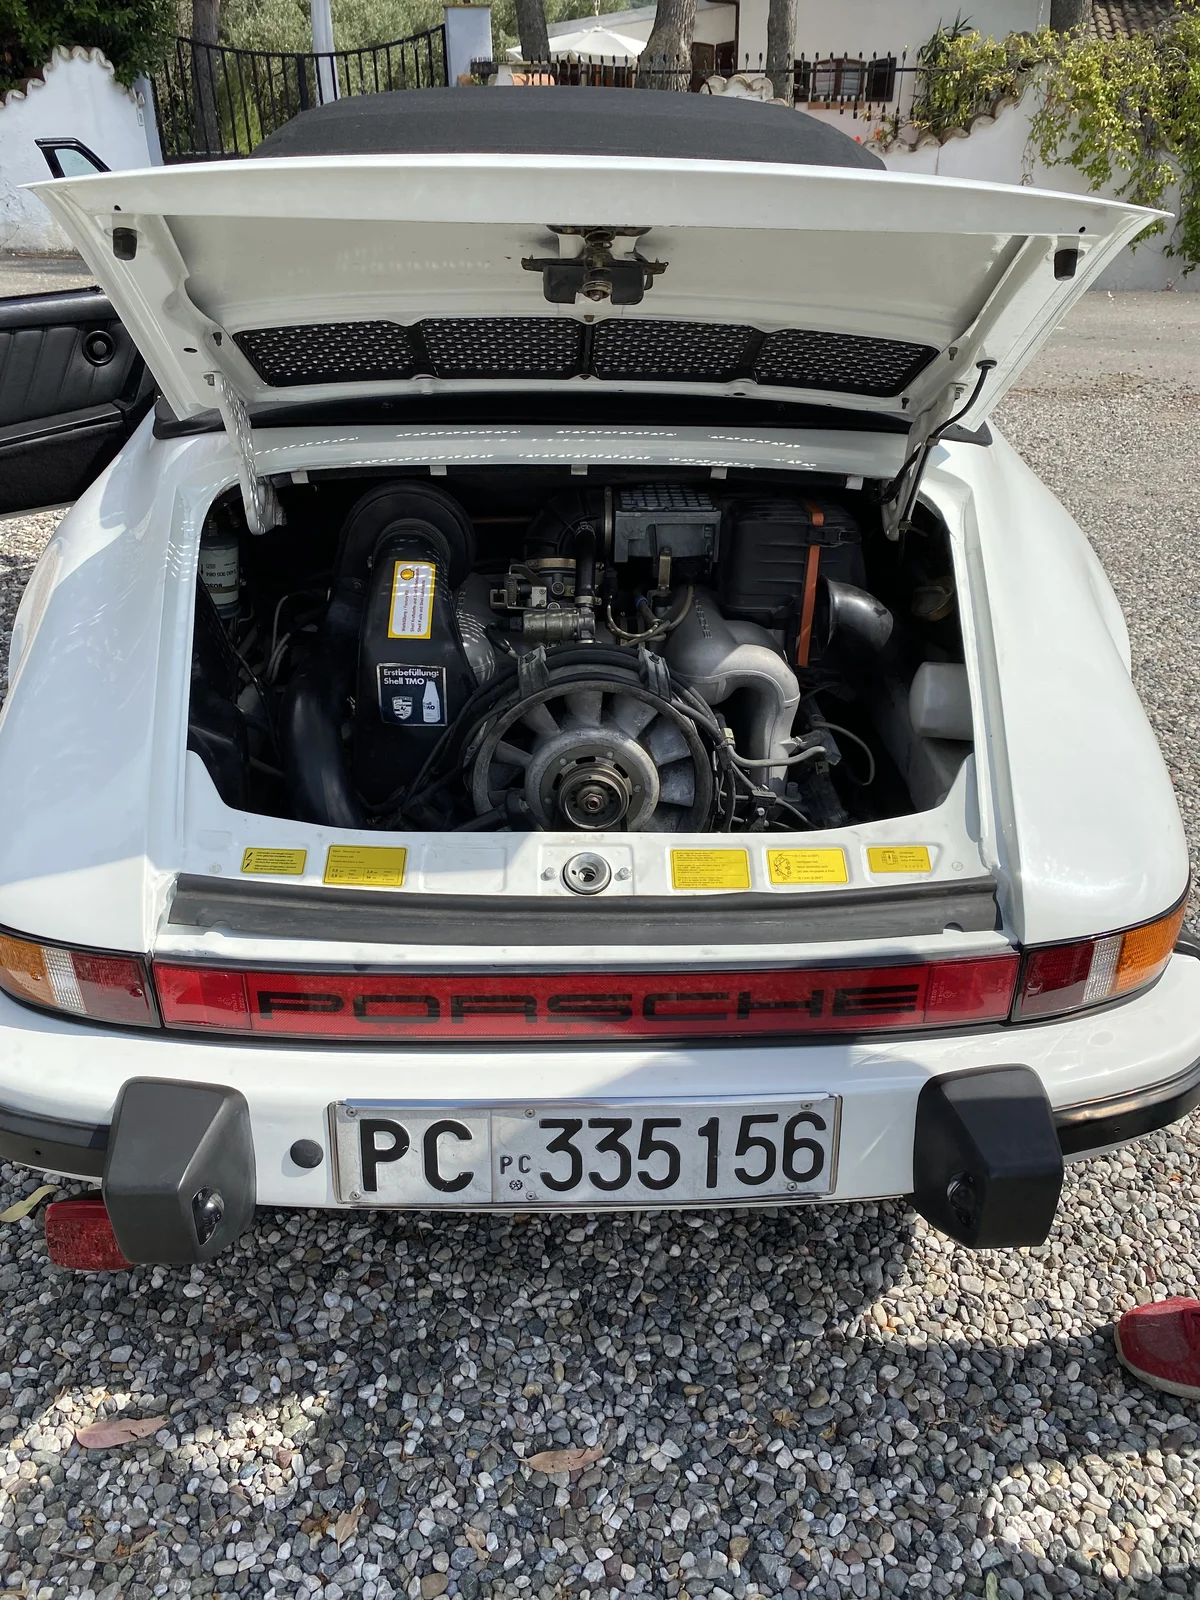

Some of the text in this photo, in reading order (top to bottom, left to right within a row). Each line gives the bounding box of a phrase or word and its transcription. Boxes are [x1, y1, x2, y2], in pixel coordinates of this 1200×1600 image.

[383, 668, 440, 679] Erstbefüllung:
[383, 677, 404, 685] Shell
[257, 989, 919, 1025] PORSCHE
[359, 1111, 827, 1193] PC PC 335156
